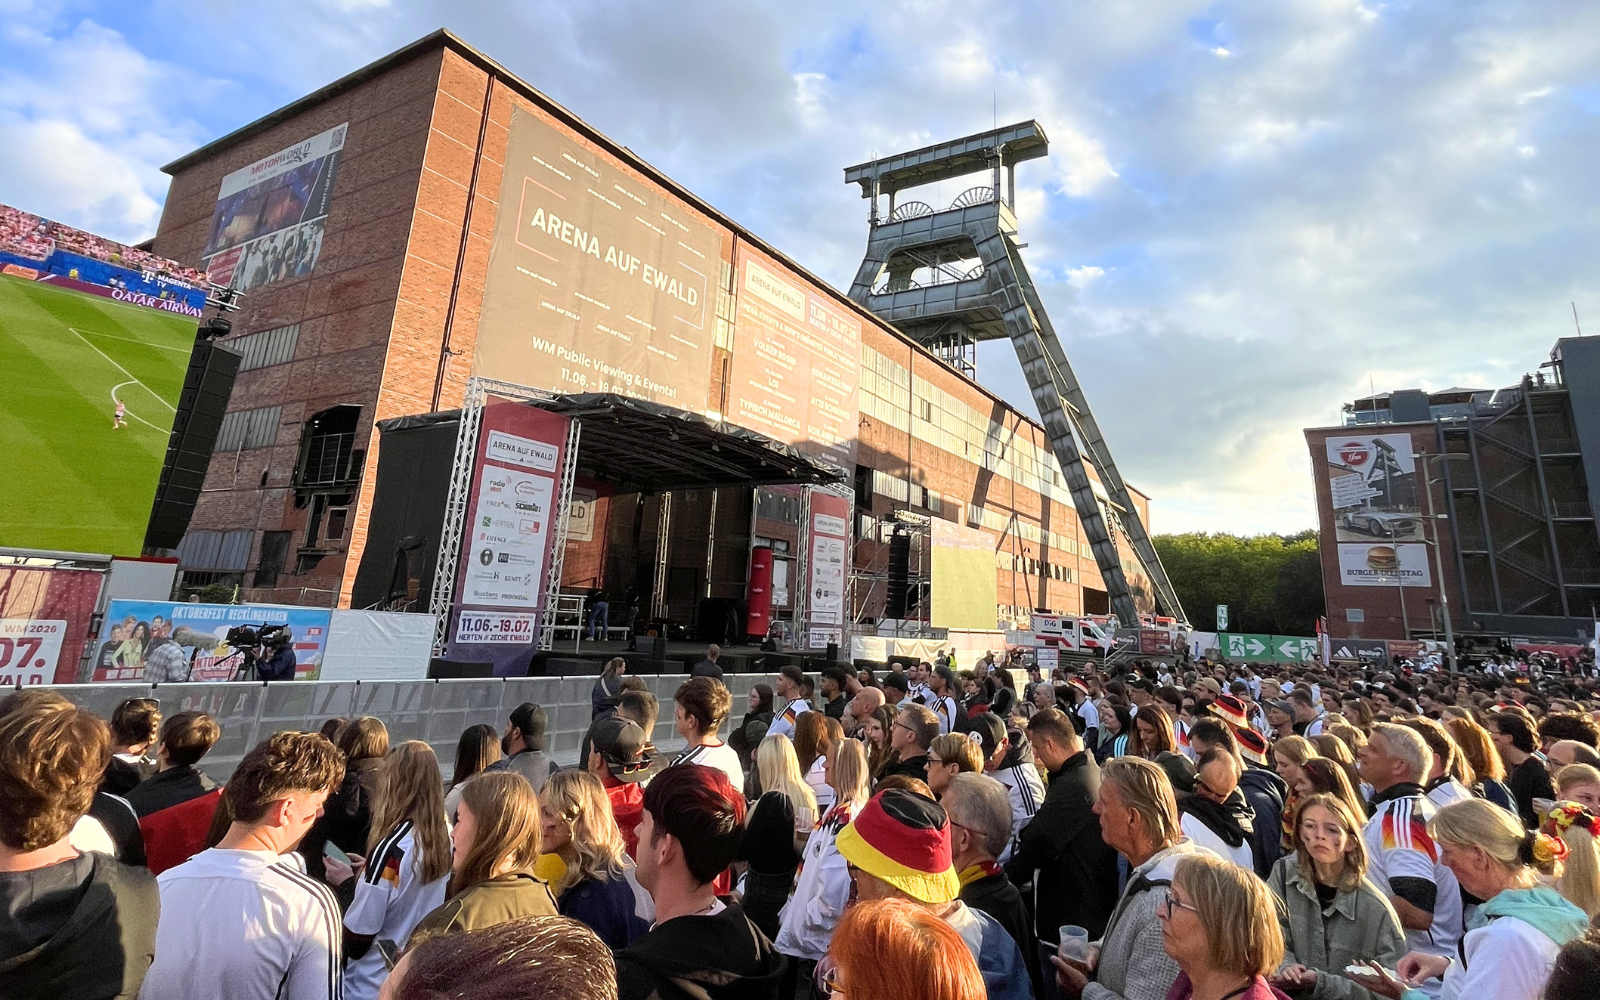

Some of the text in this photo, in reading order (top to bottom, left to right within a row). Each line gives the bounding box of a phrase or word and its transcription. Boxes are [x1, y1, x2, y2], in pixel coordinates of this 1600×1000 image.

[252, 142, 310, 174] MOTORWORLD
[530, 207, 698, 307] ARENA AUF EWALD
[158, 275, 191, 290] MAGENTA
[751, 275, 800, 309] ARENA AUF EWALD
[112, 288, 156, 306] QATAR
[753, 338, 778, 357] VOLKER
[532, 336, 677, 398] WM Public Viewing & Events!
[561, 368, 589, 387] 11.06.
[811, 397, 824, 409] ATZE
[740, 398, 768, 416] TYPISCH
[768, 408, 800, 429] MALLORCA
[492, 441, 553, 460] ARENA AUF EWALD
[492, 520, 514, 528] HERTEN
[172, 607, 288, 622] OKTOBERFEST RECKLINGHAUSEN
[5, 625, 57, 633] WM 2026
[462, 618, 531, 633] 11.06.-19.07.
